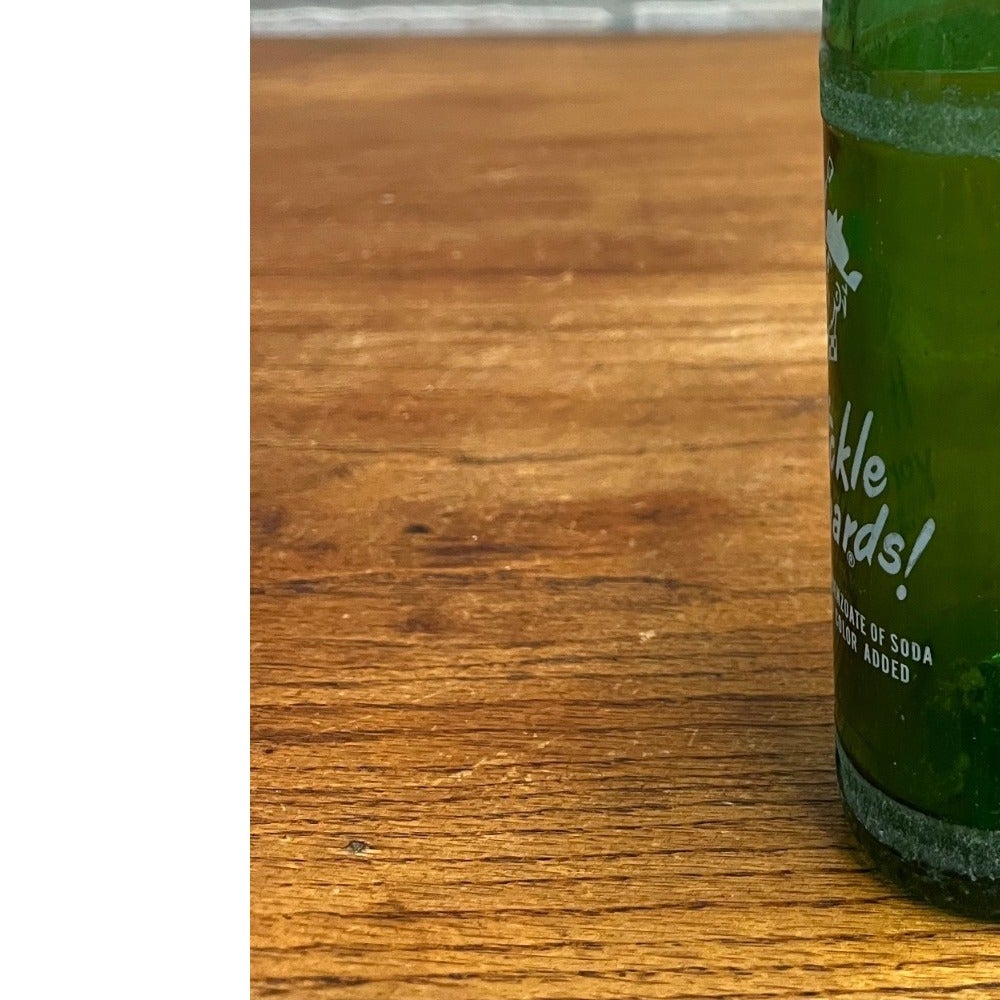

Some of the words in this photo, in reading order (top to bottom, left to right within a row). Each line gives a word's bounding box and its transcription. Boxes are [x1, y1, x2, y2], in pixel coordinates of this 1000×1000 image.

[864, 643, 910, 683] ADDED
[870, 622, 885, 646] OF
[890, 633, 933, 666] SODA
